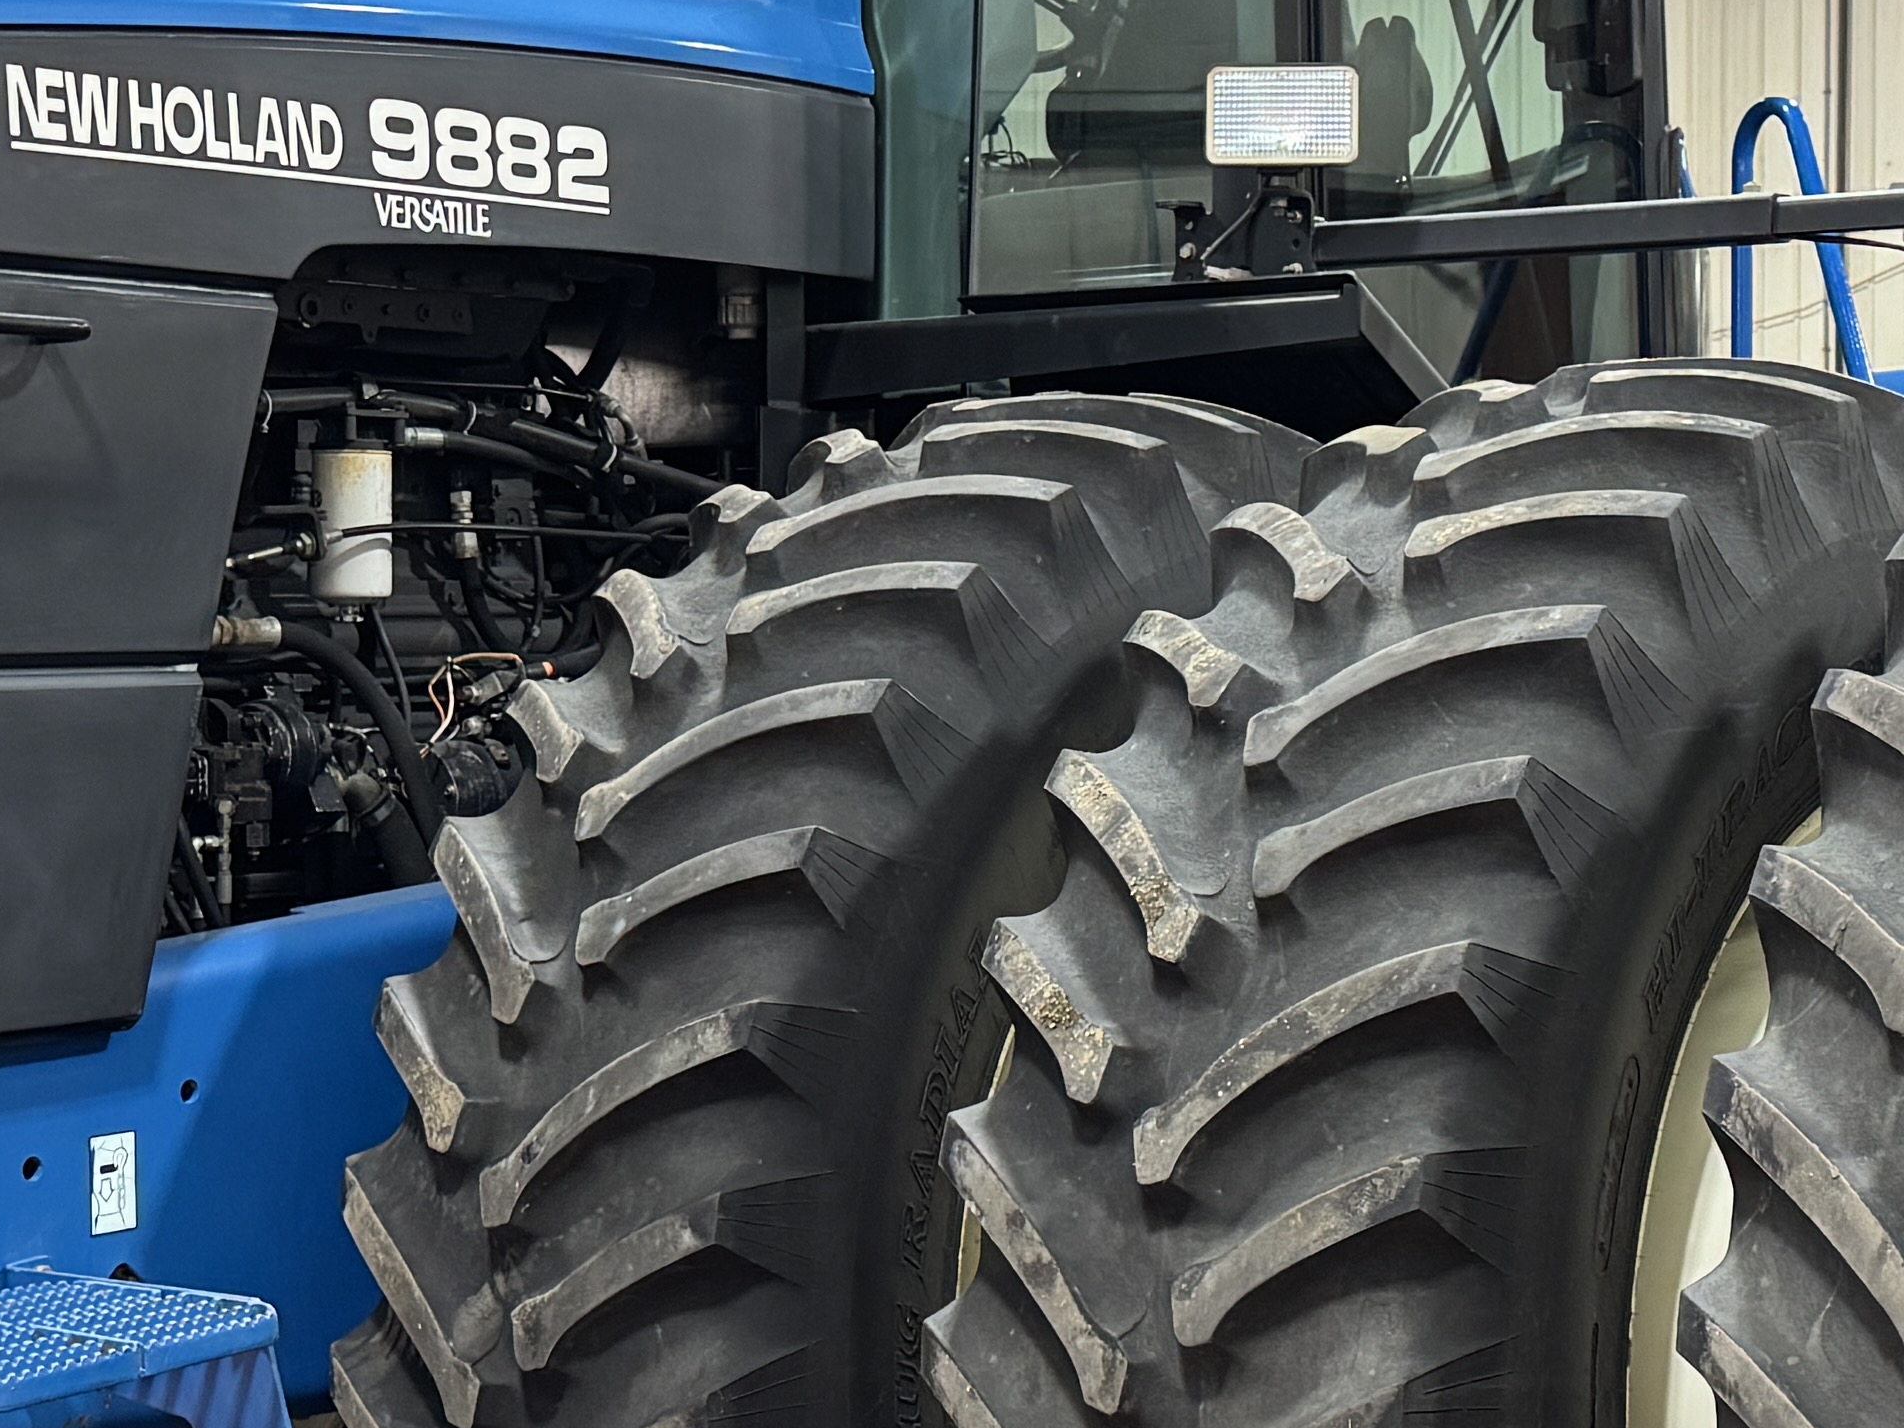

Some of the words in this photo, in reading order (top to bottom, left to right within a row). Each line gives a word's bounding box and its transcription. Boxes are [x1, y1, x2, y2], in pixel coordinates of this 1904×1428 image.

[5, 62, 120, 148] NEW
[127, 80, 344, 171] HOLLAND
[368, 97, 611, 204] 9882
[373, 192, 493, 239] VERSATILE
